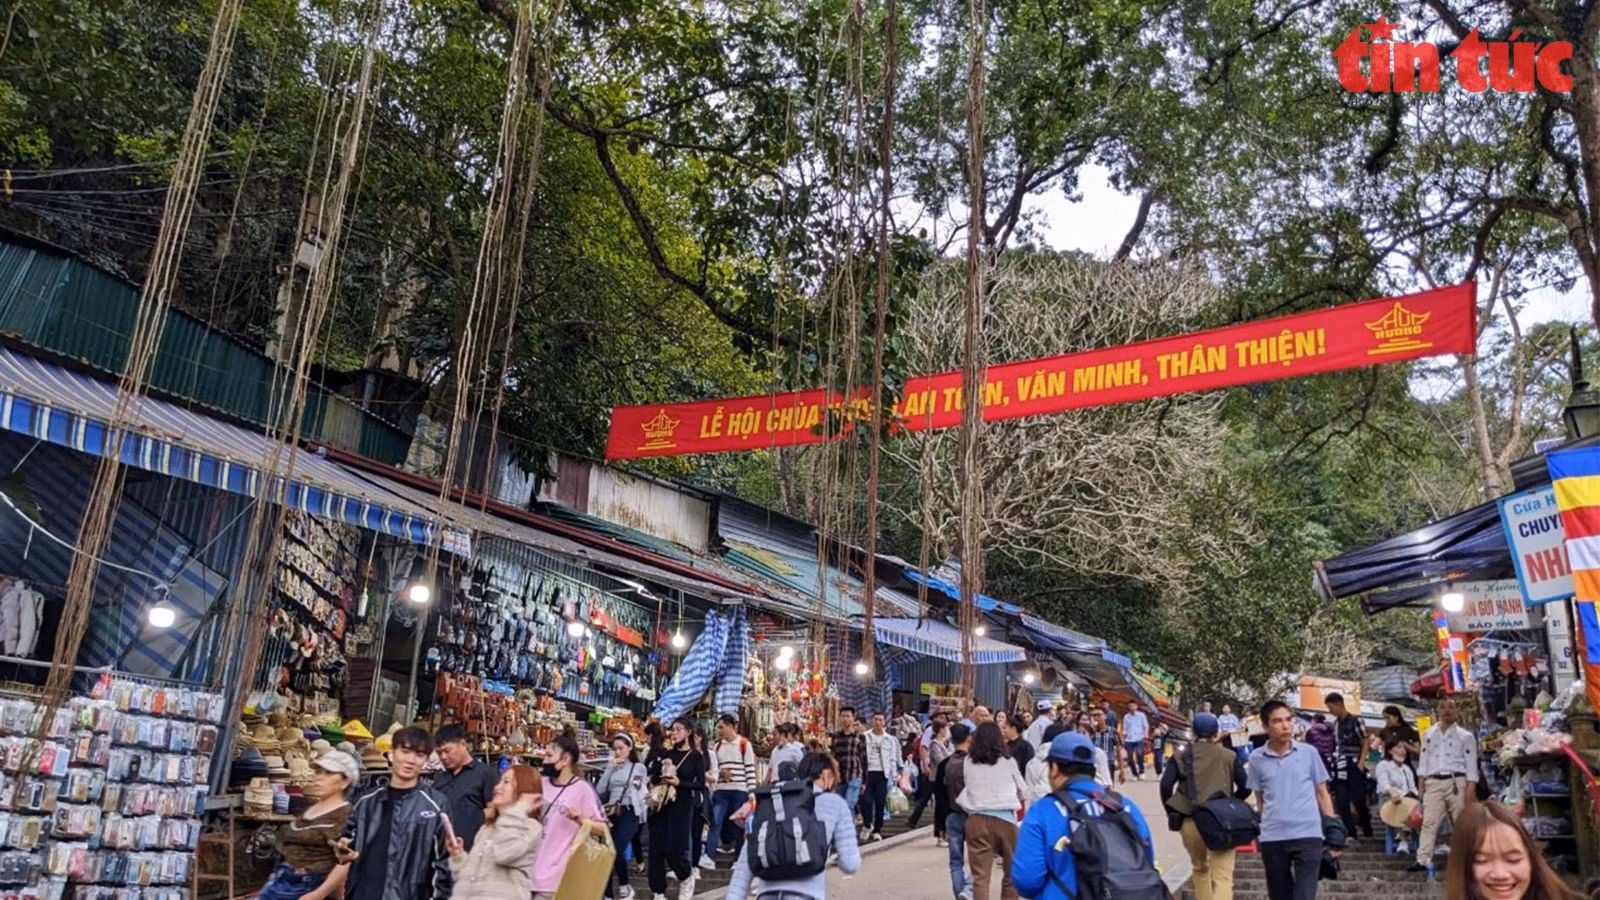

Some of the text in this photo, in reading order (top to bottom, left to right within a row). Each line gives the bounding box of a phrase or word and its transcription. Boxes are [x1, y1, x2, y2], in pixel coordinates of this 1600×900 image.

[700, 406, 724, 439] LỄ
[727, 406, 761, 440] HỘI
[766, 401, 820, 433] CHÙA
[904, 389, 937, 416] AN
[1017, 369, 1066, 401] VĂN
[1072, 358, 1149, 394] MINH,
[1156, 344, 1227, 380] THÂN
[1235, 328, 1326, 367] THIỆN!
[1518, 513, 1564, 538] CHUY
